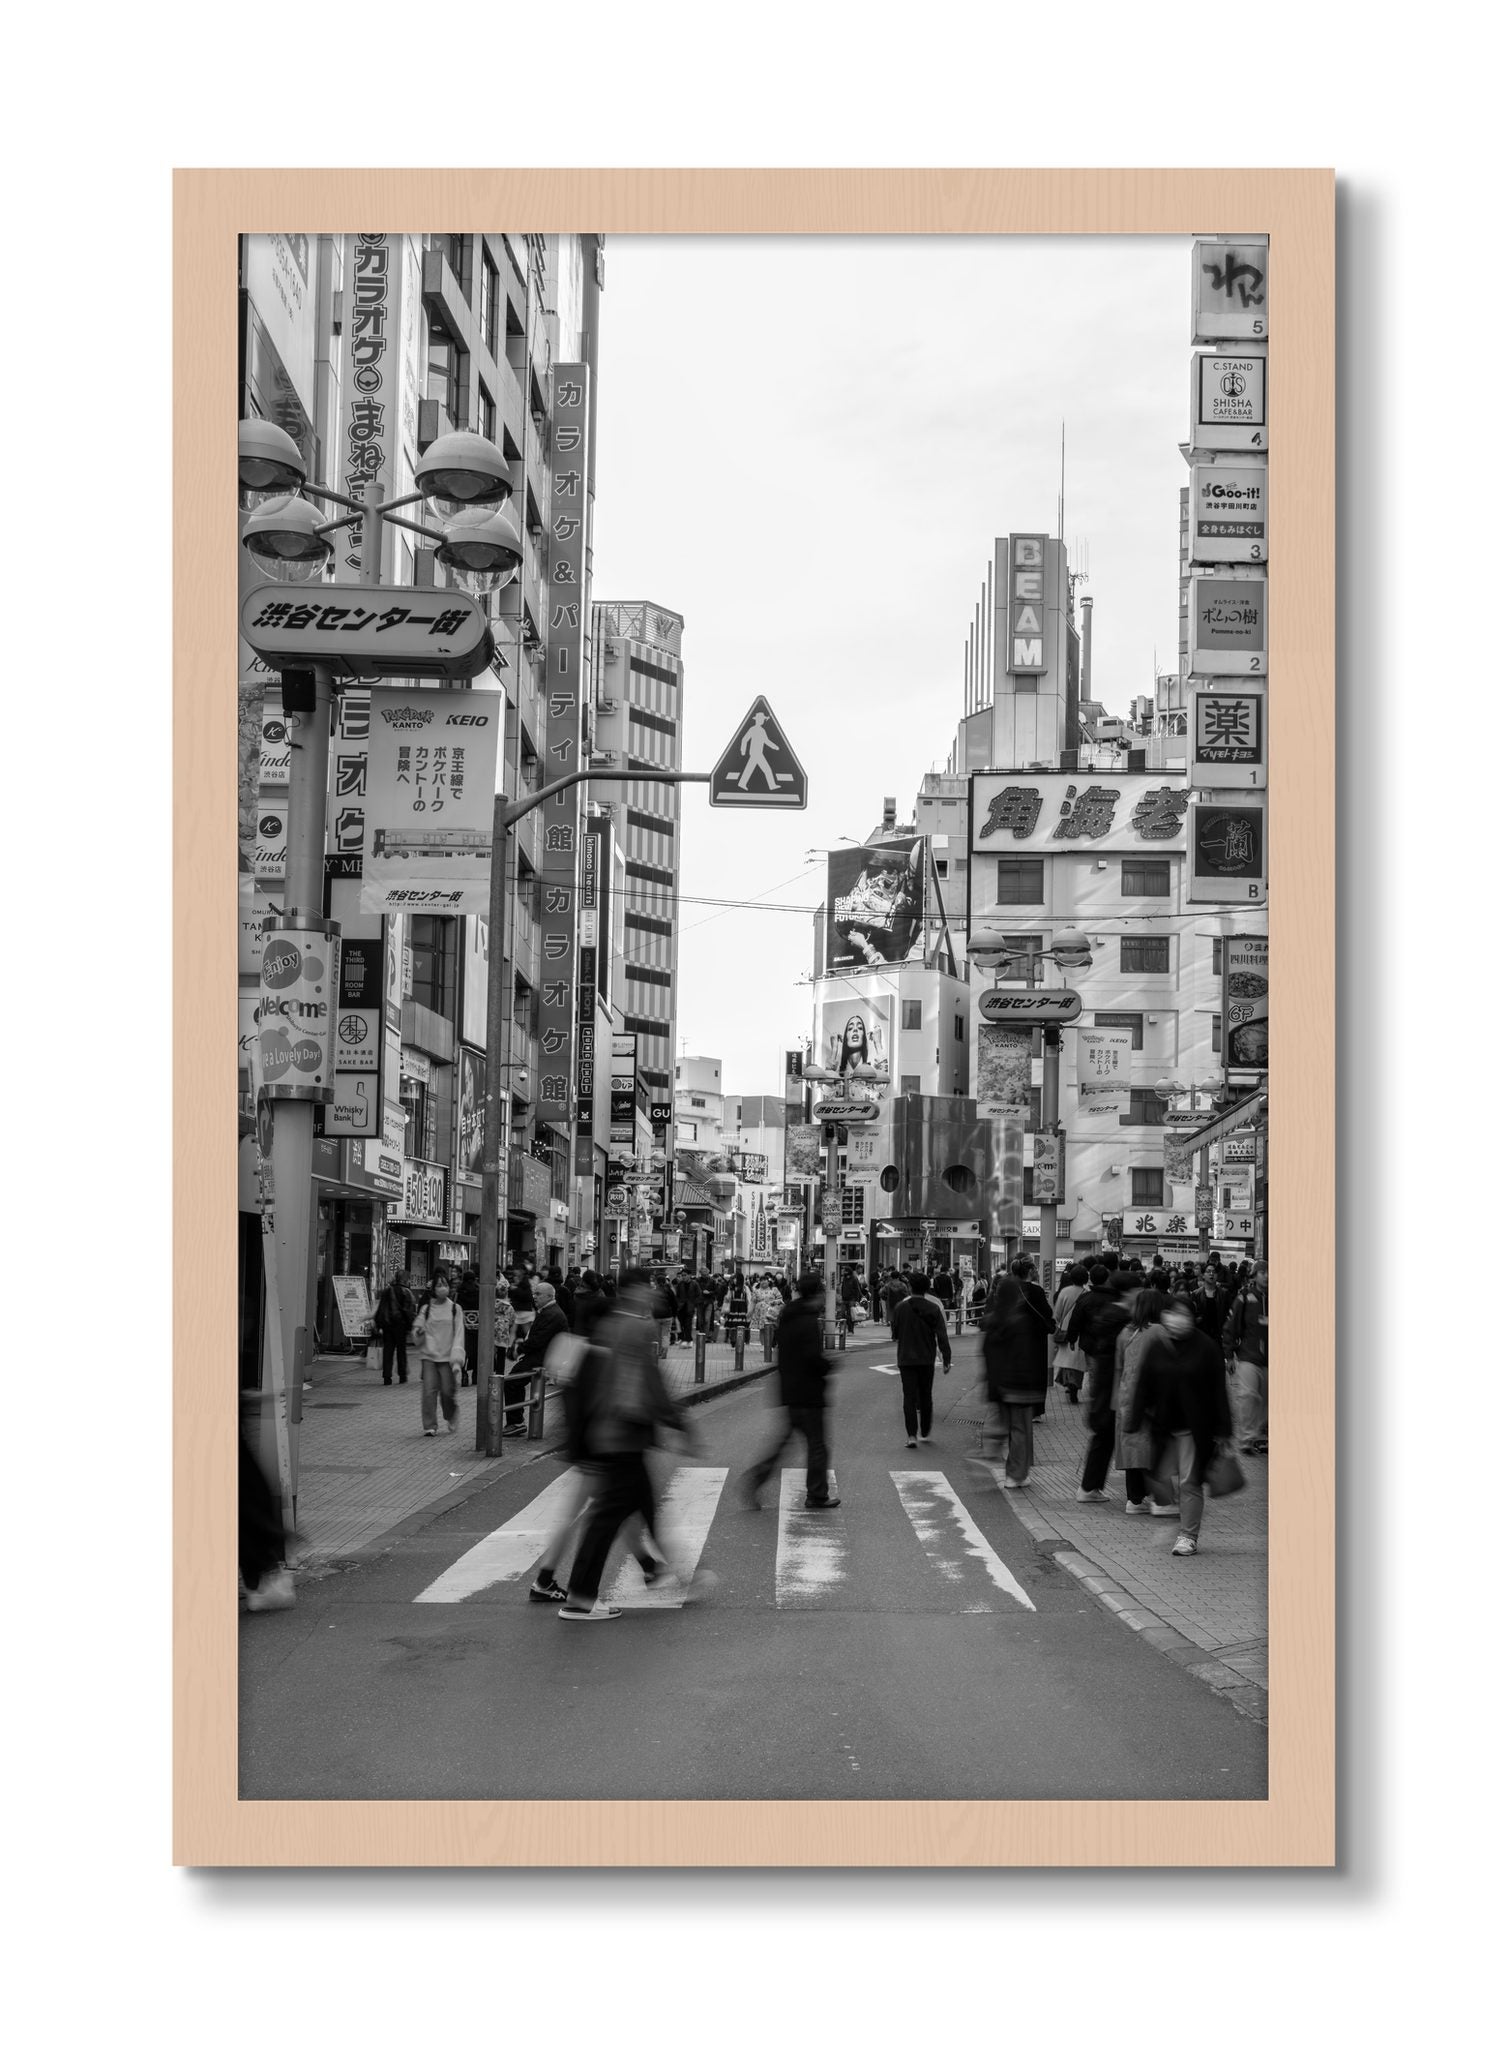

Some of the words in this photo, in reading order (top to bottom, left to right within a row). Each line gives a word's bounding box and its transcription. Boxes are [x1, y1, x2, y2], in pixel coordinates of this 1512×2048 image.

[351, 244, 389, 366] カラオケ
[1252, 320, 1264, 334] 5
[1213, 362, 1253, 371] C.STAND
[1213, 398, 1253, 408] SHISHA
[1201, 525, 1262, 534] 全身もみほぐし
[1250, 545, 1261, 559] 3
[1013, 538, 1044, 667] BEAM
[252, 602, 472, 635] 渋谷センター街
[1250, 657, 1261, 671] 2
[445, 714, 489, 727] KEIO
[1205, 700, 1250, 745] 薬
[397, 746, 411, 785] 冒険へ
[263, 770, 286, 779] 渋谷店
[413, 746, 429, 813] カントーの
[450, 747, 465, 800] 京王線で
[1250, 770, 1257, 785] 1
[259, 865, 282, 873] 渋谷店
[385, 889, 464, 902] 渋谷センター街
[585, 873, 593, 905] hearts
[1248, 884, 1259, 898] B
[263, 951, 299, 982] Enjoy
[540, 886, 572, 1103] カラオケ館
[260, 995, 328, 1018] Welcome
[985, 997, 1076, 1009] 渋谷センター街
[1228, 1005, 1255, 1023] 6F
[275, 1047, 302, 1065] Lovely
[303, 1048, 321, 1061] Day!
[334, 1106, 364, 1115] Whisky
[652, 1108, 670, 1118] GU
[816, 1105, 872, 1115] 渋谷センター街
